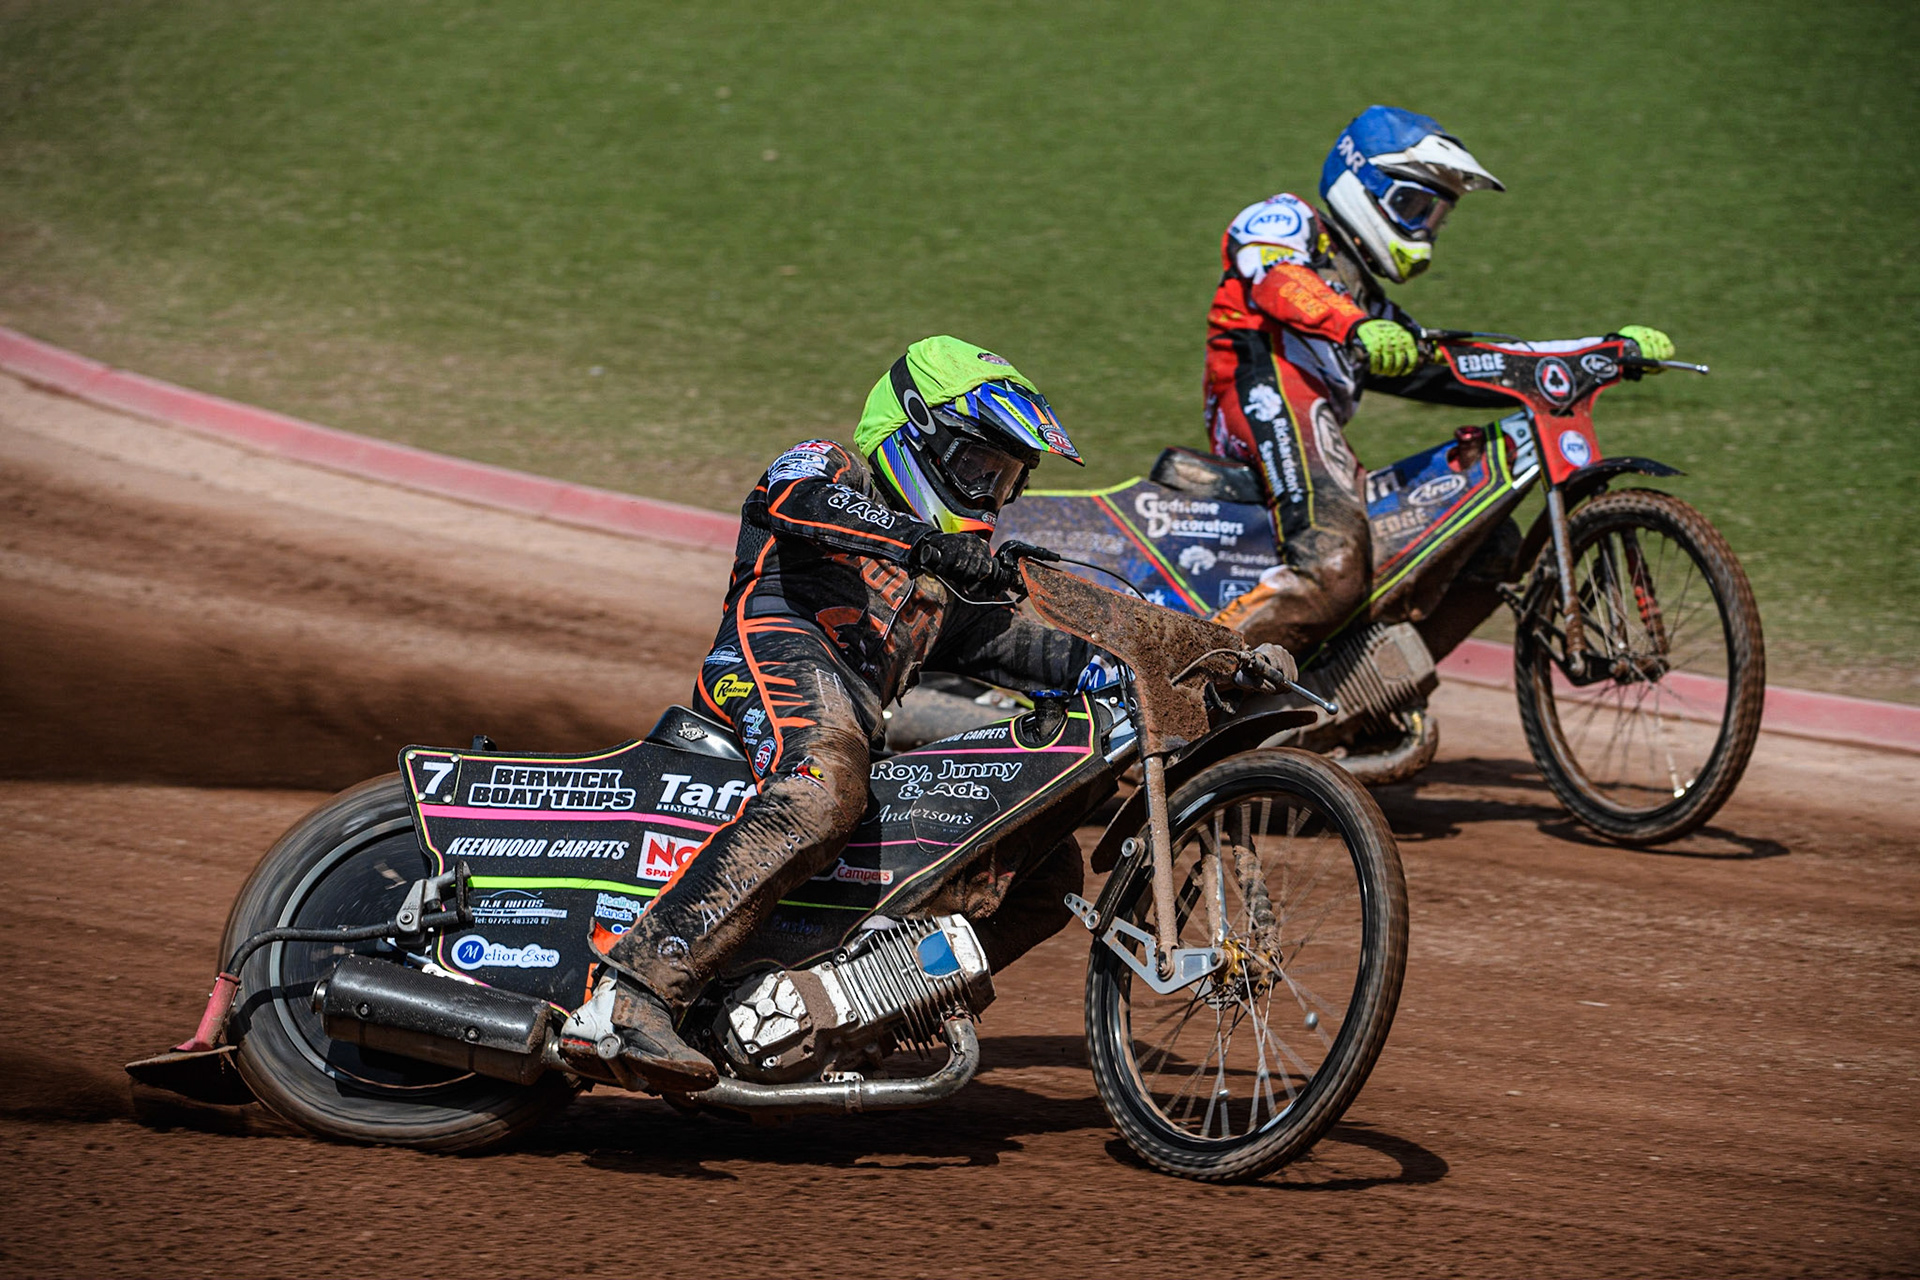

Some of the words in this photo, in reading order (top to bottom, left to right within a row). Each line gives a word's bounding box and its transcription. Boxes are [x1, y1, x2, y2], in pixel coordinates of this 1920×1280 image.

[1457, 353, 1506, 373] EDGE
[1046, 431, 1073, 449] STS
[1420, 477, 1459, 500] Arai
[828, 491, 850, 509] &
[846, 501, 895, 529] Ada
[1146, 512, 1244, 538] Decorators
[1374, 507, 1431, 537] EDGE
[1217, 550, 1278, 567] Richardso
[963, 727, 1009, 741] CARPETS
[422, 762, 454, 795] 7
[492, 766, 622, 789] BERWICK
[870, 760, 933, 784] Roy,
[937, 759, 1022, 782] Jinny
[469, 784, 546, 808] BOAT
[550, 787, 636, 810] TRIPS
[898, 783, 924, 800] &
[926, 781, 990, 800] Ada
[879, 804, 974, 825] Anderson's
[446, 837, 548, 858] KEENWOOD
[547, 839, 630, 860] CARPETS
[837, 866, 891, 882] Campers
[598, 893, 639, 912] Healing
[462, 945, 517, 962] Melior
[521, 949, 556, 963] Esse
